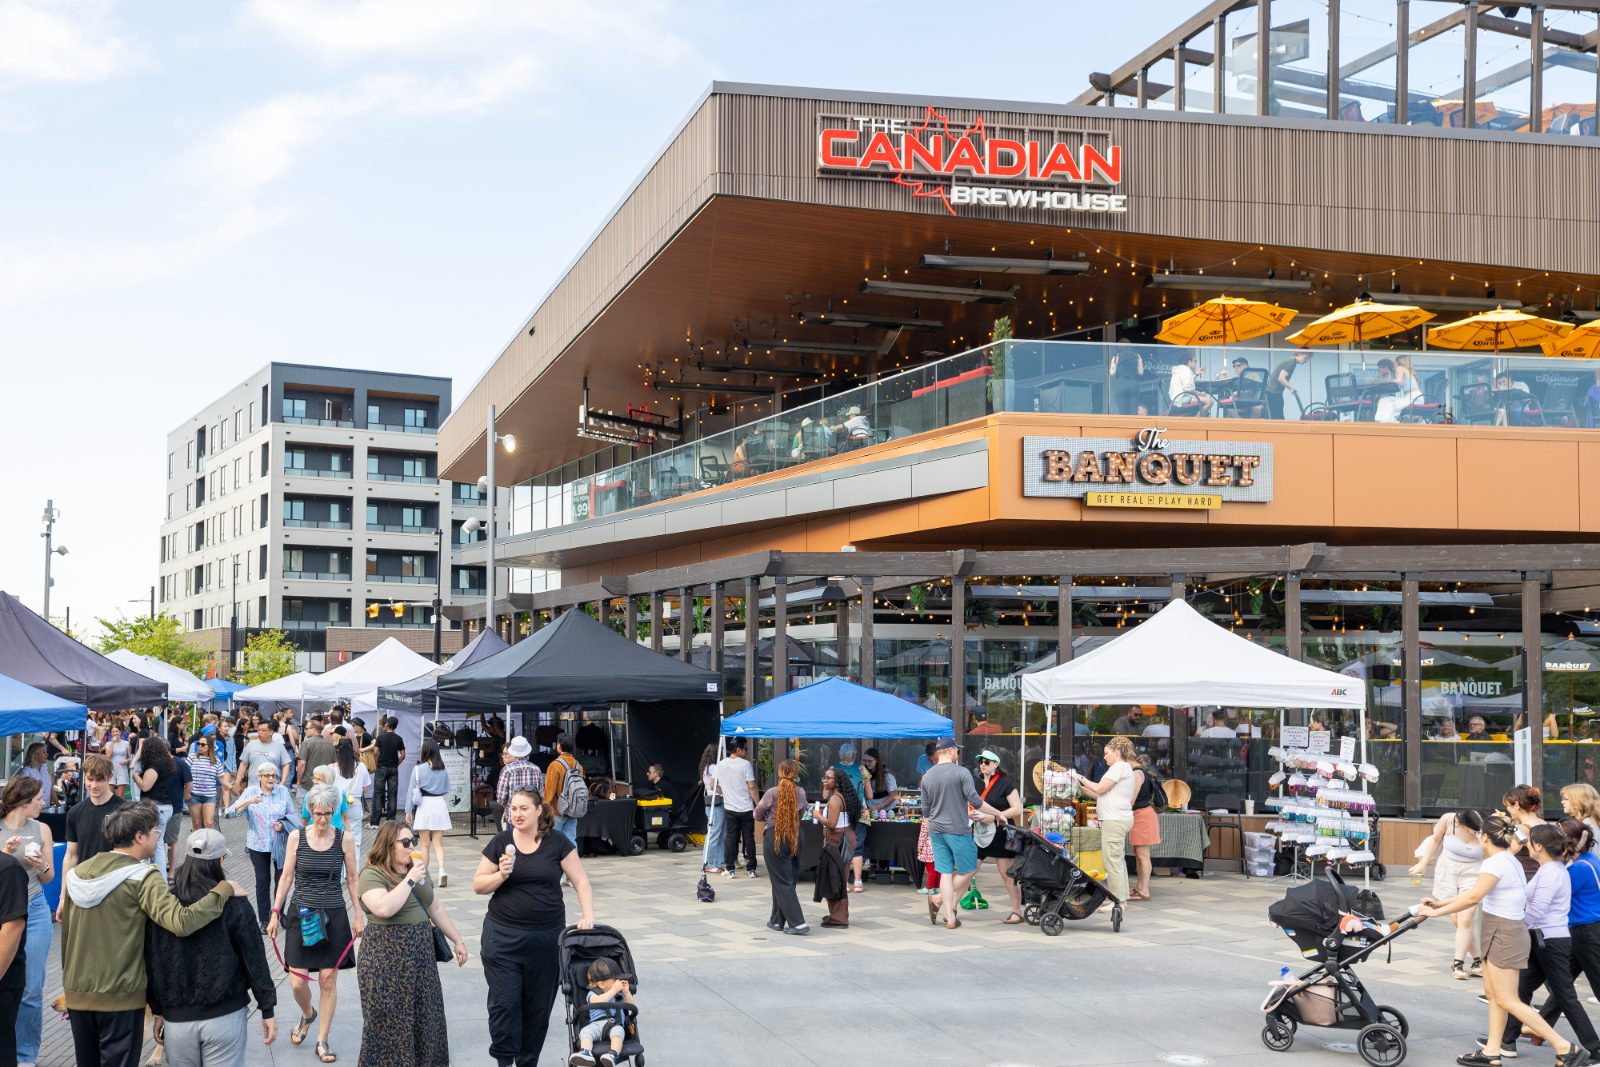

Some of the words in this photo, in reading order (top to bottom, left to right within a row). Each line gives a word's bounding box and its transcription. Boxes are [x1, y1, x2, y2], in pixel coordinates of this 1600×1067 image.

[853, 116, 906, 135] THE
[818, 128, 1122, 185] CANADIAN
[950, 186, 1128, 214] BREWHOUSE
[1198, 334, 1227, 342] Coron
[1319, 334, 1347, 342] Corona
[1136, 427, 1170, 452] The
[1044, 449, 1261, 487] BANQUET
[1096, 494, 1115, 505] GET
[1120, 495, 1144, 506] REAL
[1158, 496, 1182, 507] PLAY
[1187, 497, 1213, 508] HARD
[1545, 661, 1592, 670] BANQUET
[984, 676, 1022, 690] BANQU
[1440, 681, 1502, 696] BANQUET
[1330, 687, 1348, 696] ABC
